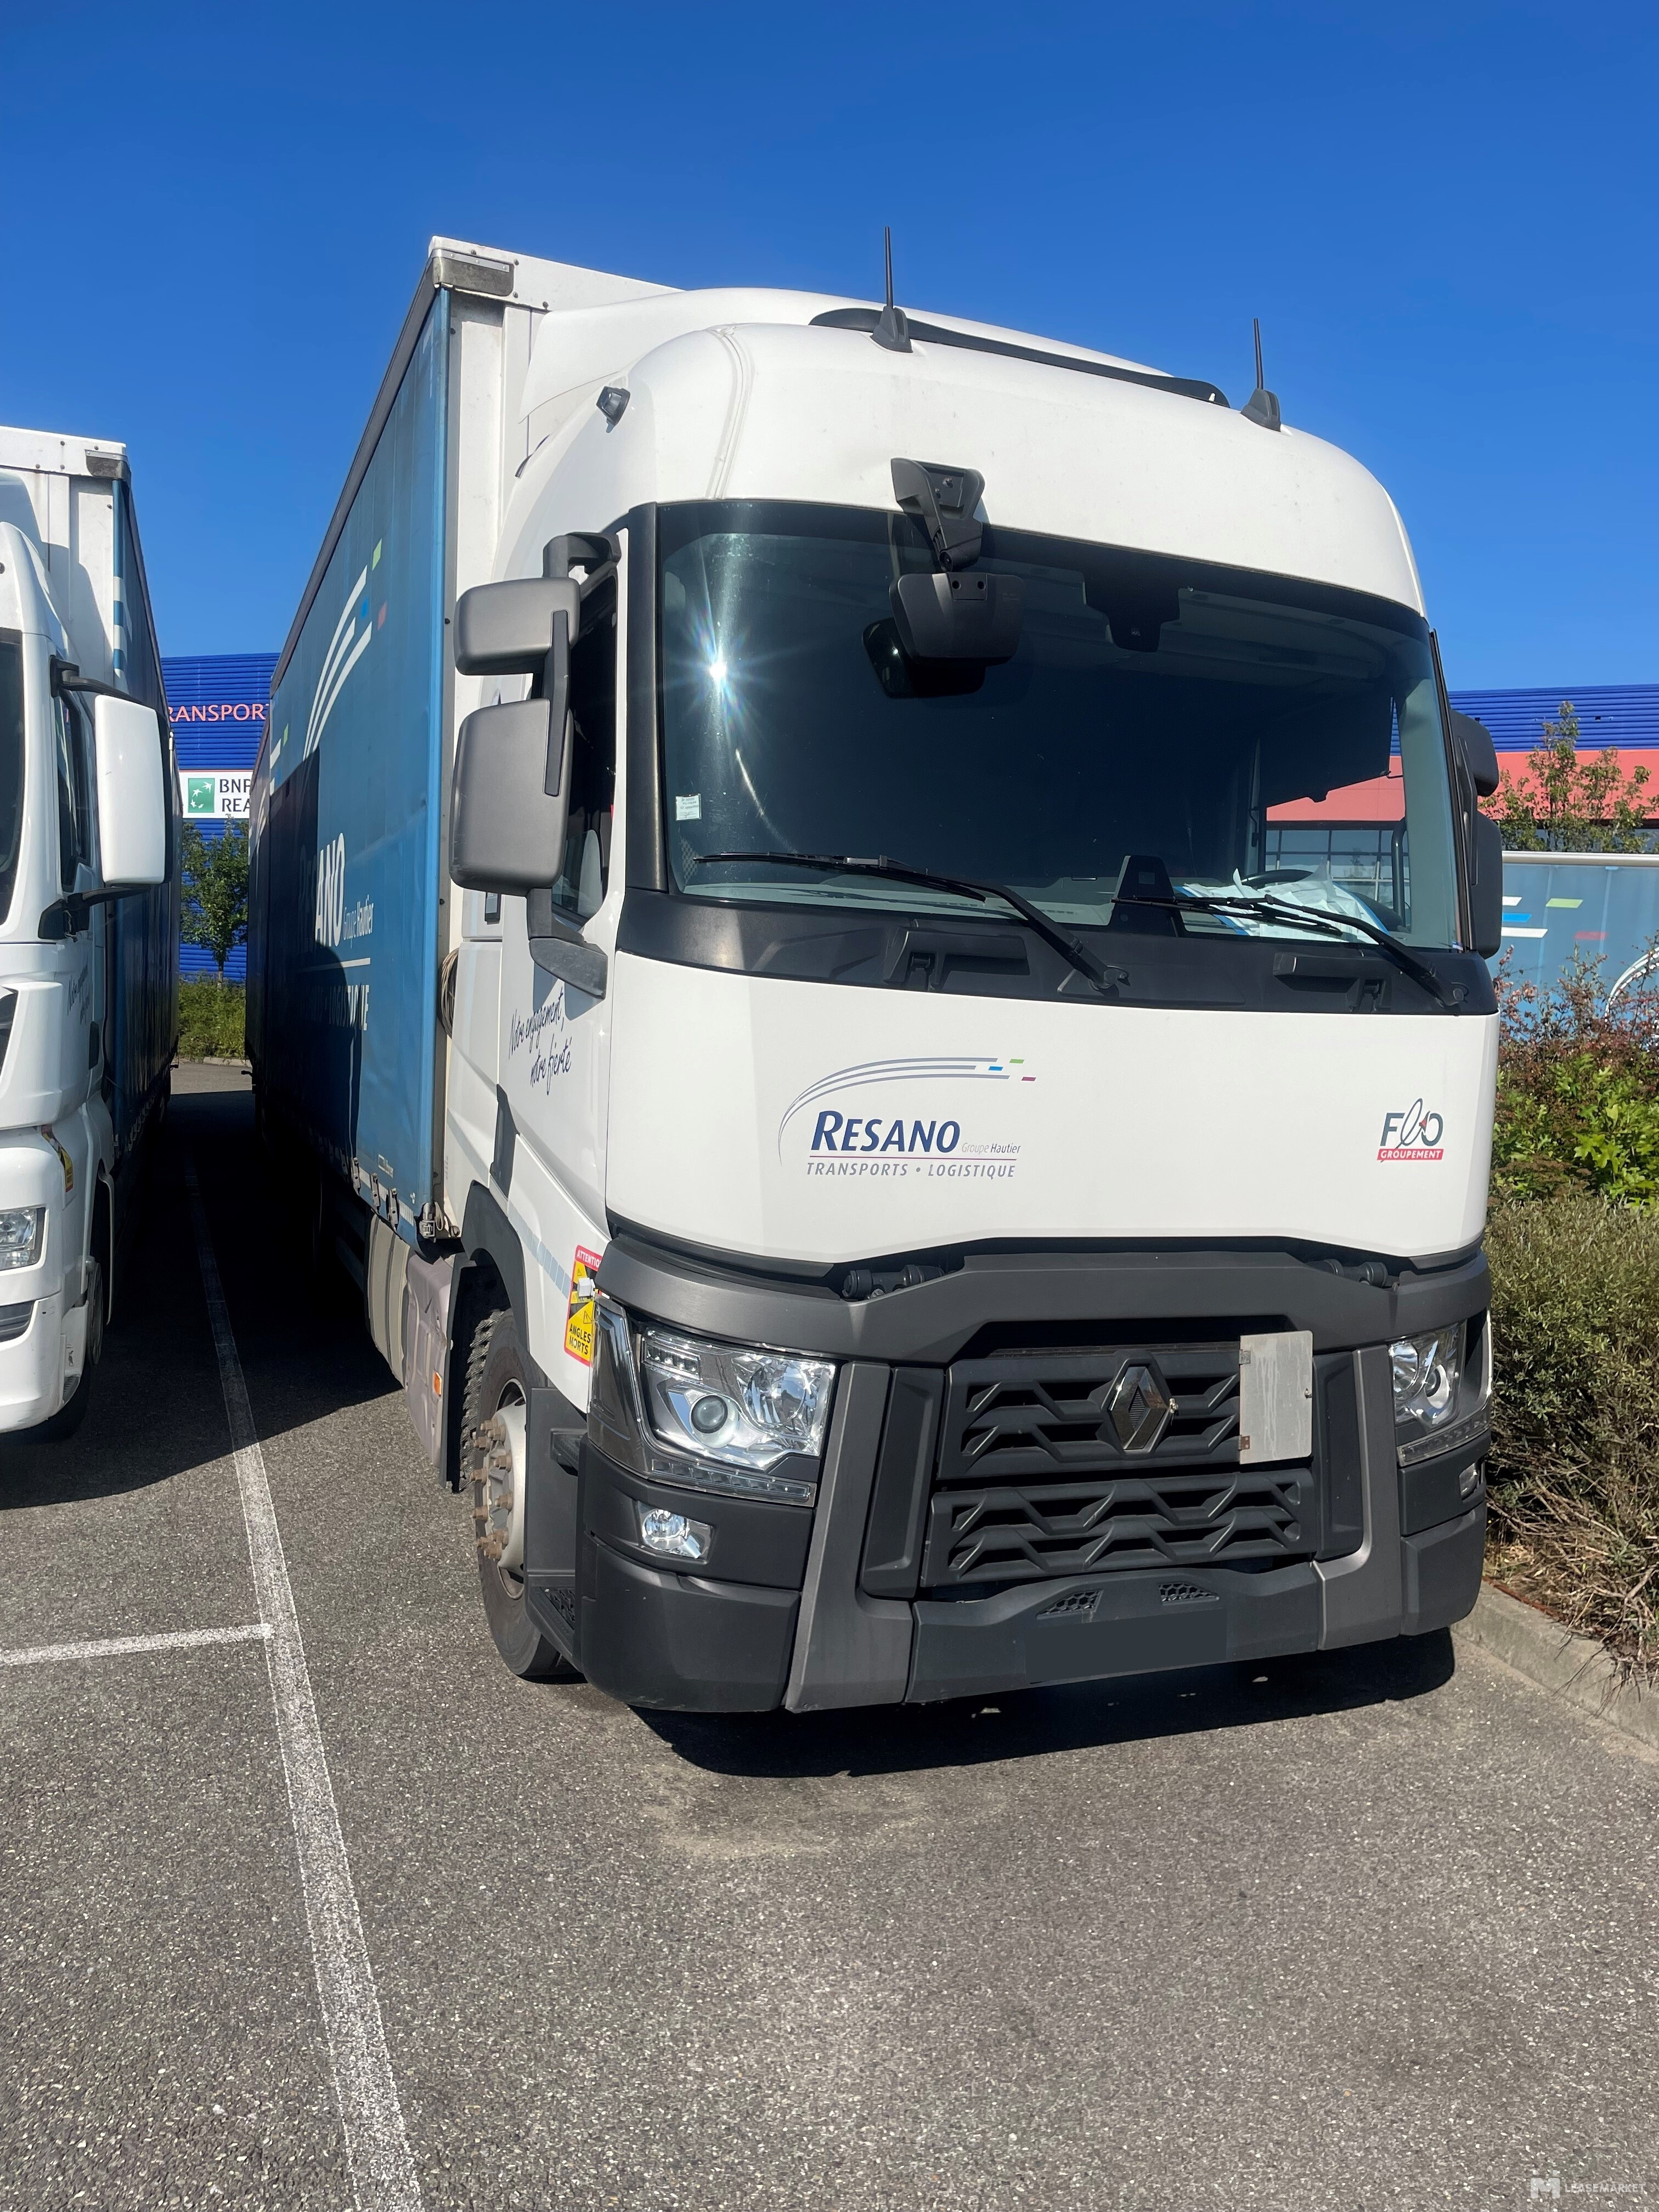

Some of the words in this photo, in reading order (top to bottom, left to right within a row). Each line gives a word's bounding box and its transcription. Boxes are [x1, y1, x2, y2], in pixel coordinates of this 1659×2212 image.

[168, 703, 269, 722] RANSPOR
[811, 1110, 961, 1153] RESANO
[961, 1142, 989, 1154] Groupe
[990, 1142, 1021, 1154] Hautier
[1380, 1150, 1442, 1159] GROUPEMENT
[807, 1163, 909, 1177] TRANSPORTS
[928, 1164, 1016, 1180] LOGISTIQUE
[569, 1323, 591, 1344] ANGLES
[569, 1335, 589, 1355] MORTS
